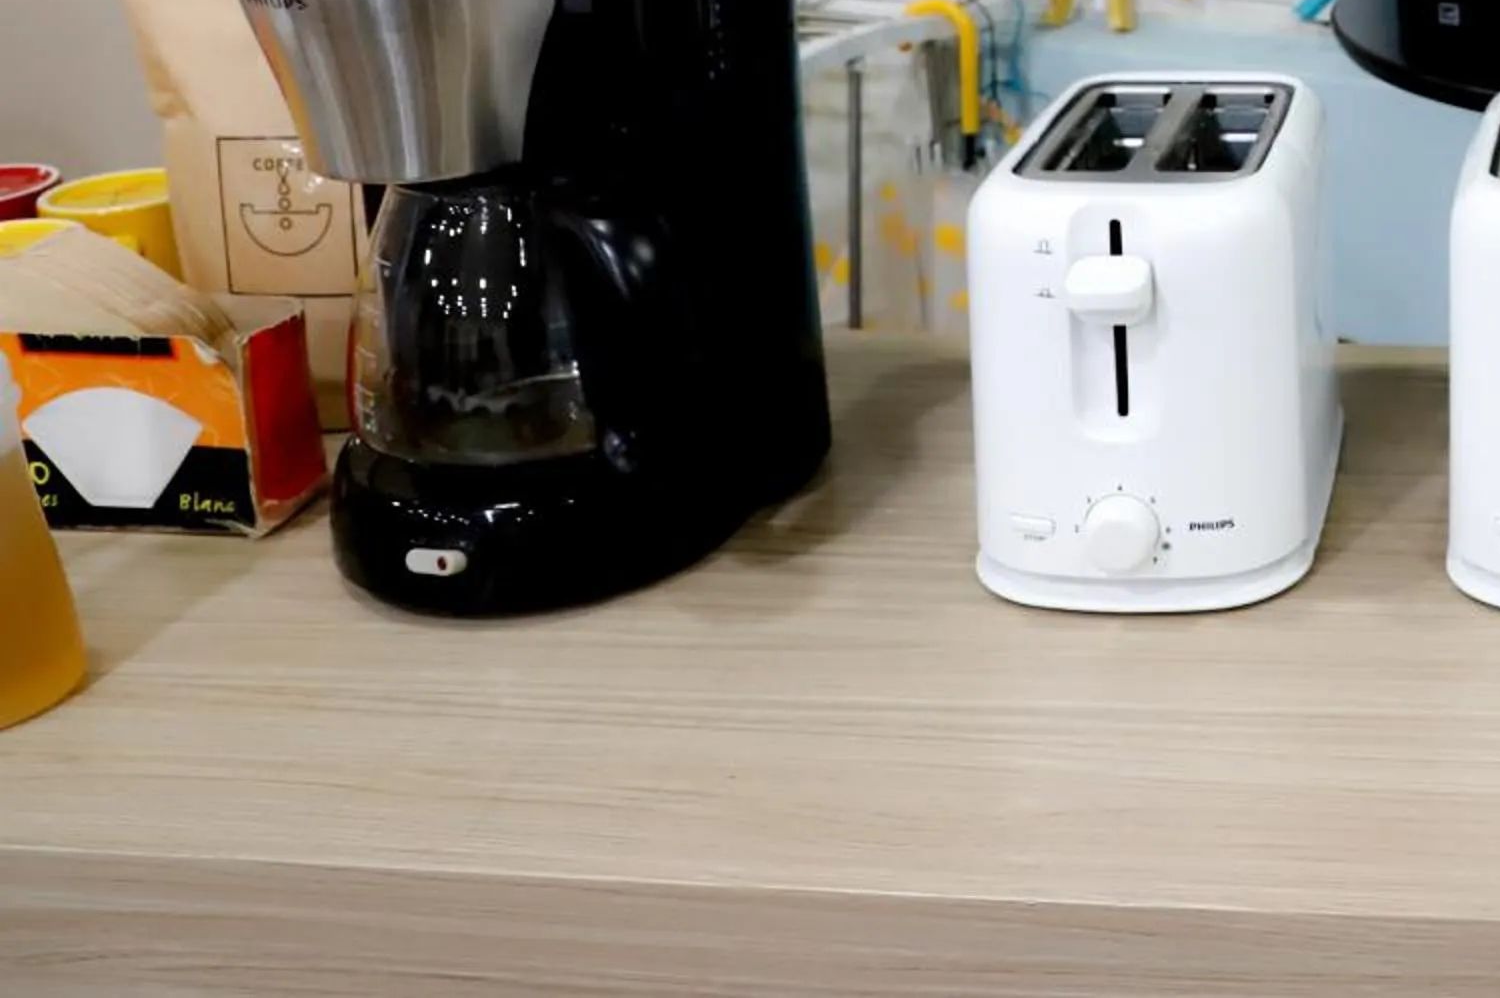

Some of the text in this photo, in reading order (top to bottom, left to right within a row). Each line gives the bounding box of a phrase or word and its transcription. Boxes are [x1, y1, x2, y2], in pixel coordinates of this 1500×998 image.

[252, 157, 305, 172] COFFE
[178, 491, 237, 513] Blanc
[1188, 518, 1236, 532] PHILIPS
